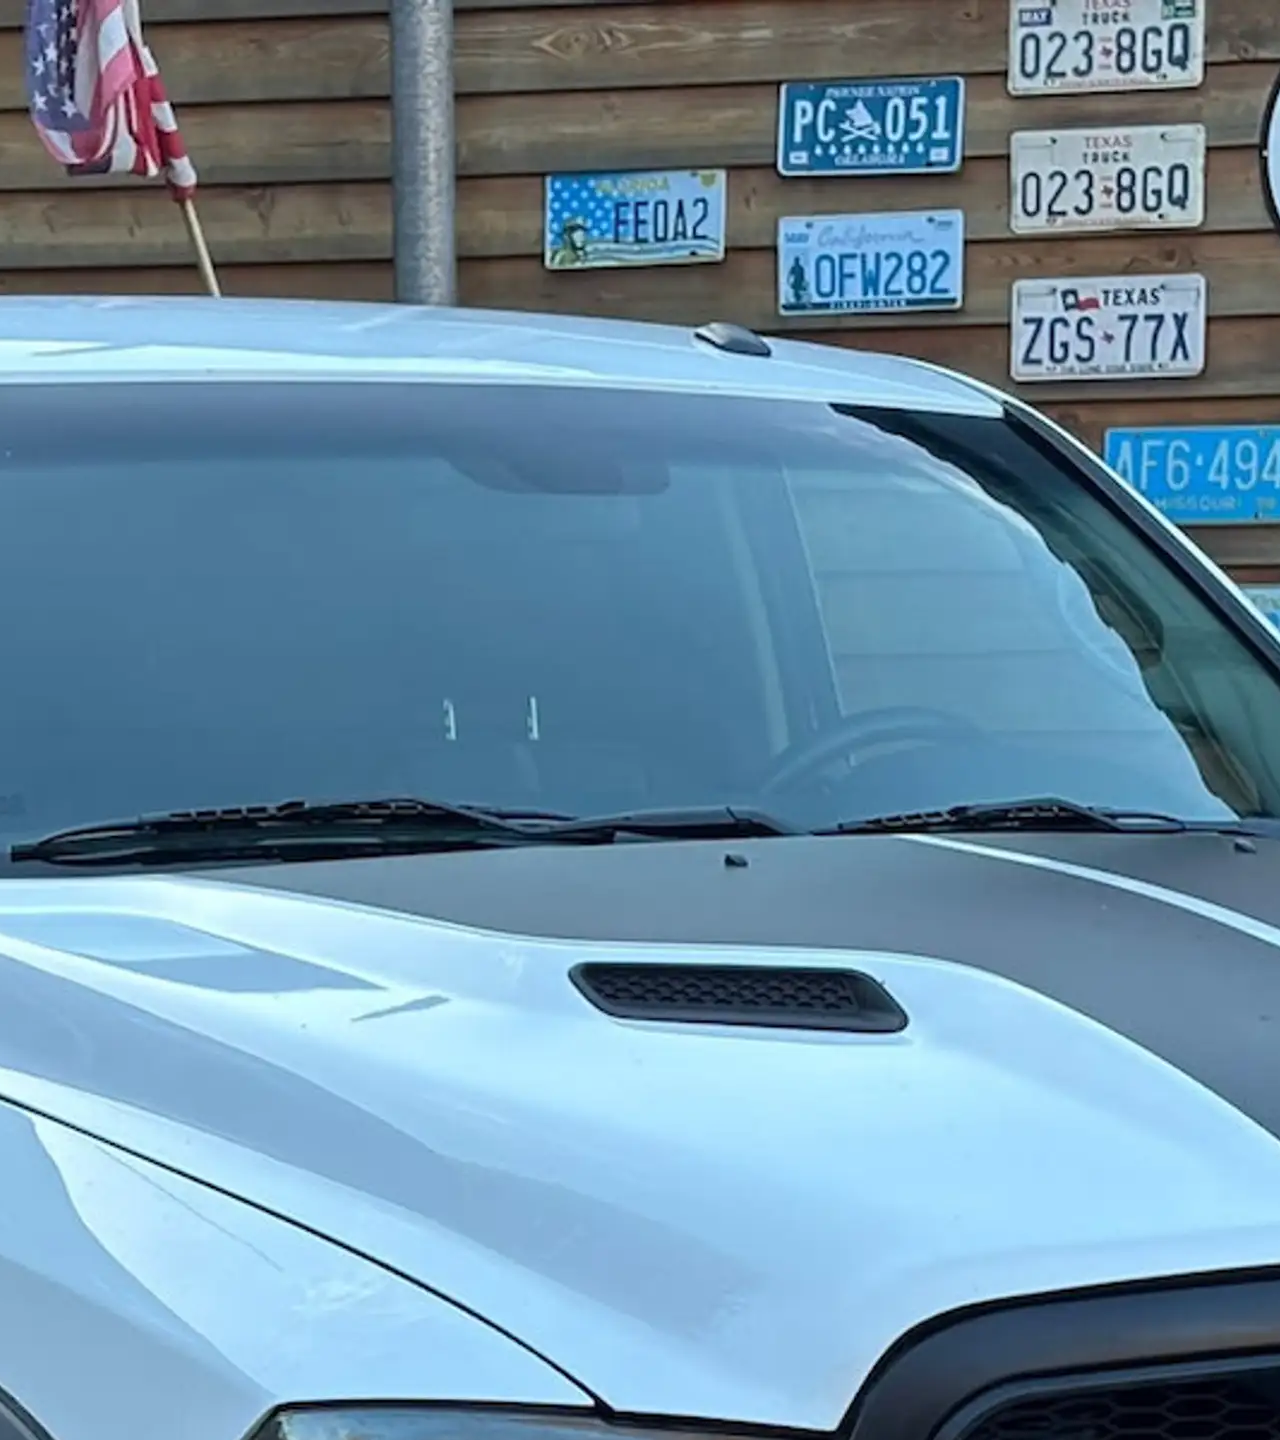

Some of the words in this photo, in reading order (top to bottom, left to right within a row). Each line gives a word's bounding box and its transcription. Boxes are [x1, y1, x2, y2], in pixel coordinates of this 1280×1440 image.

[1081, 12, 1130, 26] TRUCK
[1020, 31, 1095, 79] 023
[1115, 23, 1189, 74] 8GQ
[793, 99, 838, 143] PC
[885, 96, 951, 142] 051
[1081, 150, 1130, 164] TRUCK
[1085, 135, 1133, 149] TEXAS
[1021, 170, 1095, 217] 023
[1115, 163, 1189, 213] 8GQ
[1102, 287, 1161, 307] TEXAS
[1022, 315, 1096, 366] ZGS
[1117, 312, 1189, 362] 77X
